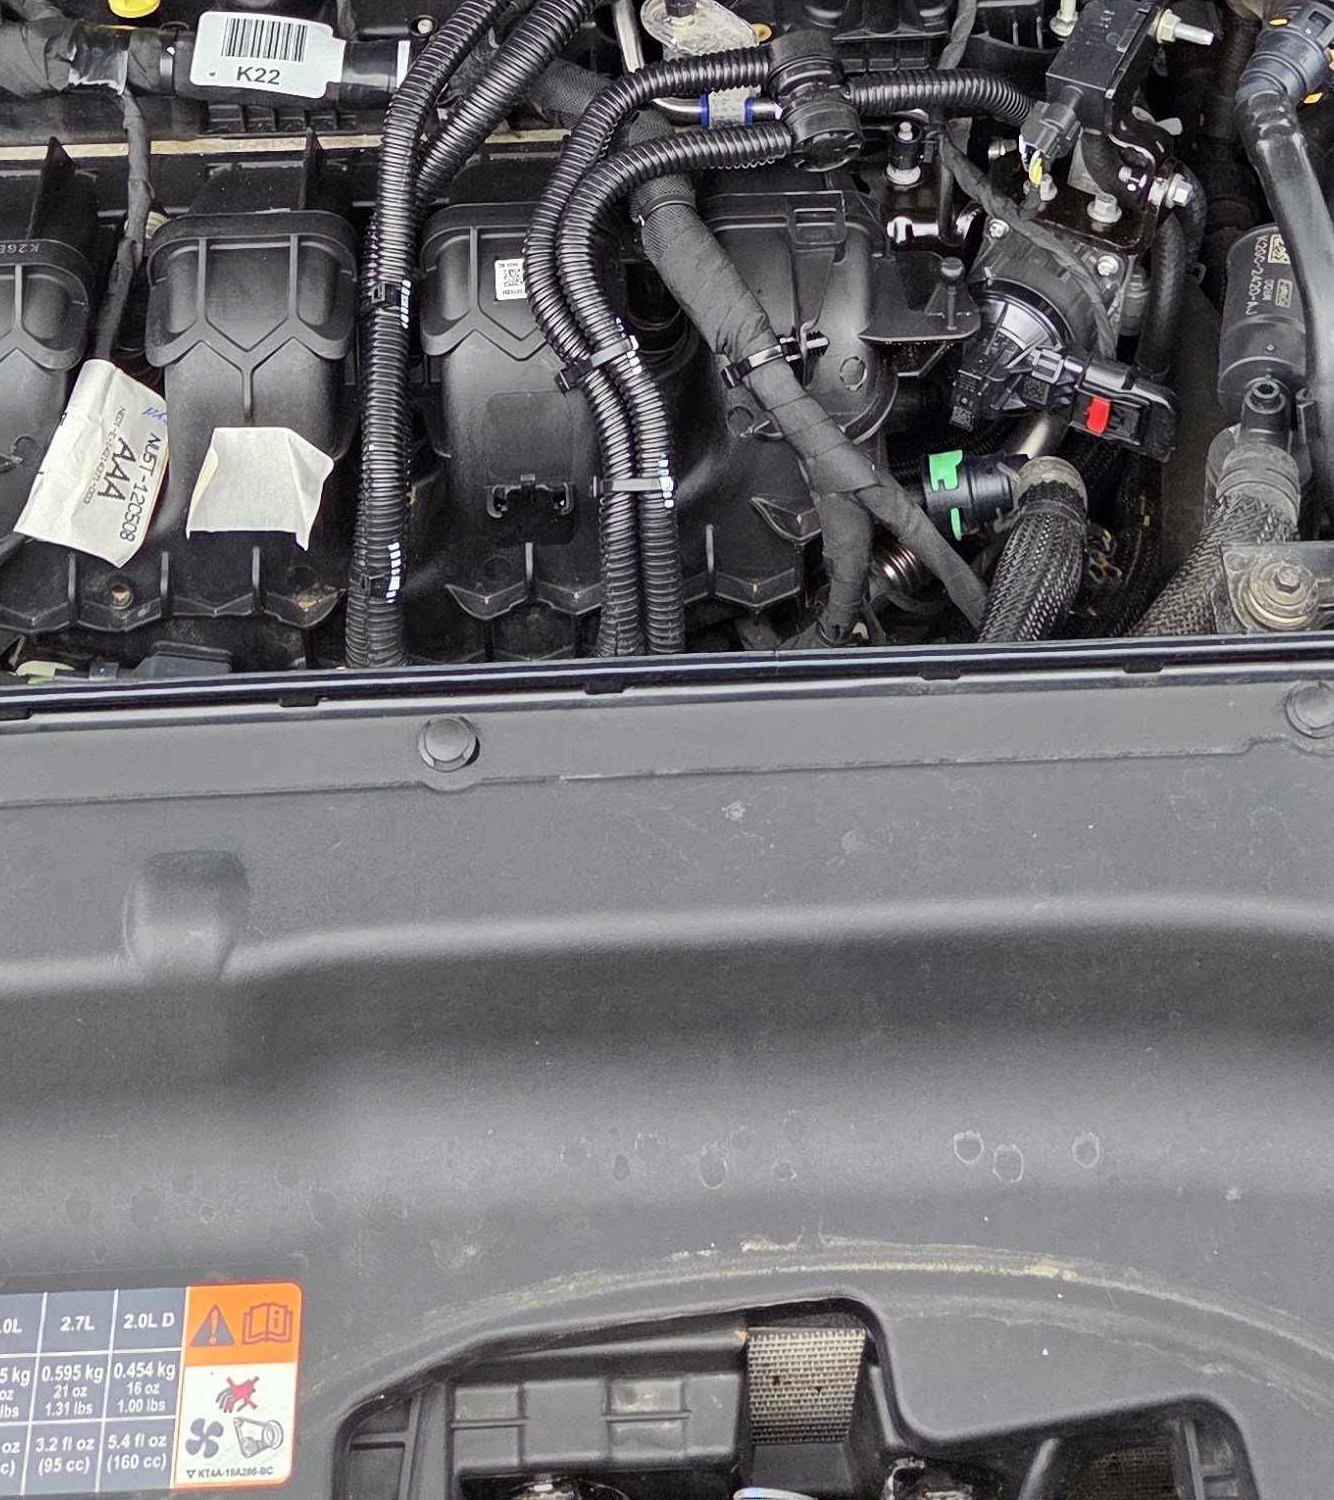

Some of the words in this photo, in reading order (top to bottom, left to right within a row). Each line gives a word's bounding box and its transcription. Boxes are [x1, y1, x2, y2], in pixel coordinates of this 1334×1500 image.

[236, 66, 281, 85] K22
[97, 436, 137, 501] AAA
[120, 433, 162, 542] NU5T-12C508
[60, 1315, 95, 1332] 2.7L
[122, 1313, 157, 1329] 2.0L
[161, 1312, 175, 1328] D
[12, 1365, 31, 1387] kg
[41, 1363, 82, 1382] 0.595
[85, 1363, 104, 1384] kg
[113, 1361, 154, 1379] 0.454
[158, 1360, 176, 1381] kg
[0, 1388, 14, 1401] oz
[53, 1385, 68, 1399] 21
[72, 1386, 87, 1398] oz
[127, 1382, 142, 1396] 16
[144, 1382, 160, 1395] oz
[0, 1403, 19, 1418] lbs
[44, 1401, 70, 1417] 1.31
[73, 1400, 93, 1416] lbs
[117, 1399, 144, 1414] 1.00
[146, 1398, 166, 1412] lbs
[2, 1441, 21, 1454] oz
[35, 1437, 58, 1452] 3.2
[61, 1436, 73, 1451] fl
[76, 1437, 95, 1450] oz
[107, 1435, 130, 1449] 5.4
[134, 1433, 145, 1448] fl
[148, 1435, 167, 1448] oz
[38, 1457, 63, 1476] (95
[66, 1456, 90, 1475] cc)
[106, 1454, 139, 1473] (160
[142, 1452, 167, 1471] cc)
